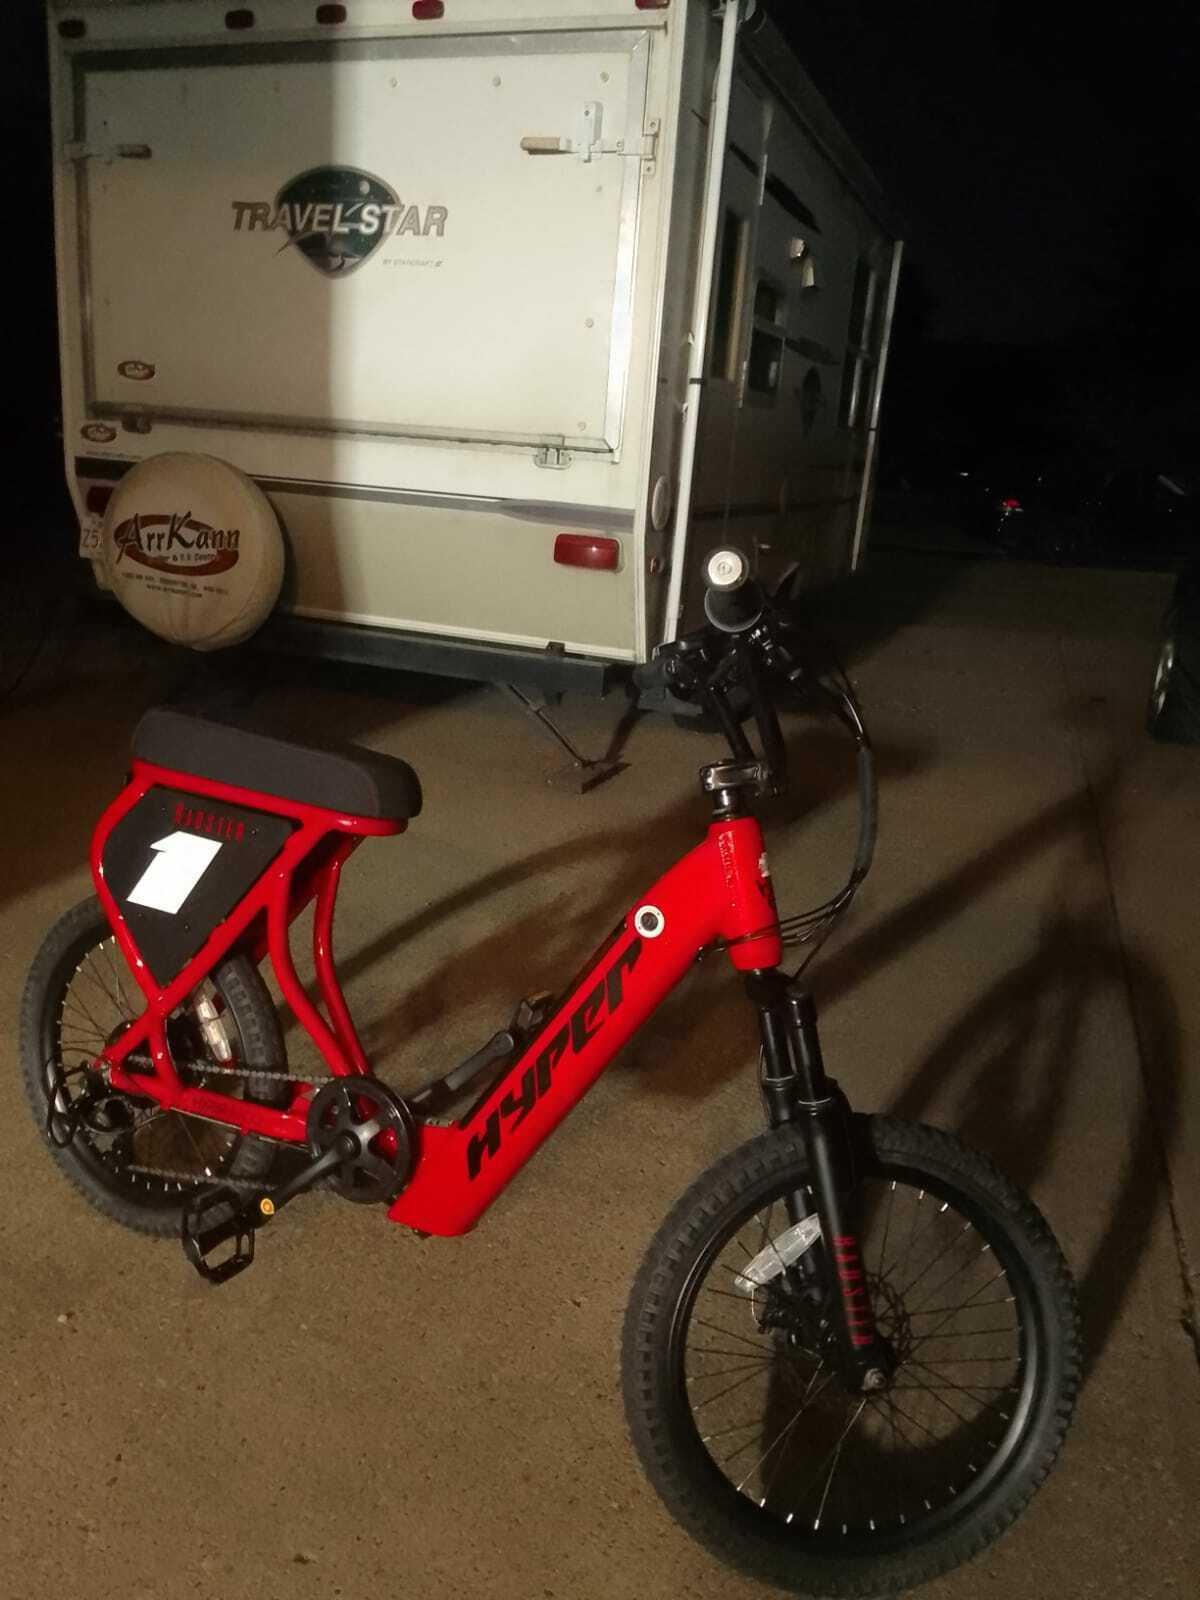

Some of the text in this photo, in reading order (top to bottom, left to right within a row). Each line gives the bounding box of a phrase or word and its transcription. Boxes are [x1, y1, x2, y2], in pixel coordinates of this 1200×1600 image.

[232, 201, 448, 237] TRAVEL STAR
[115, 511, 240, 565] ArrKann
[126, 831, 223, 914] 1
